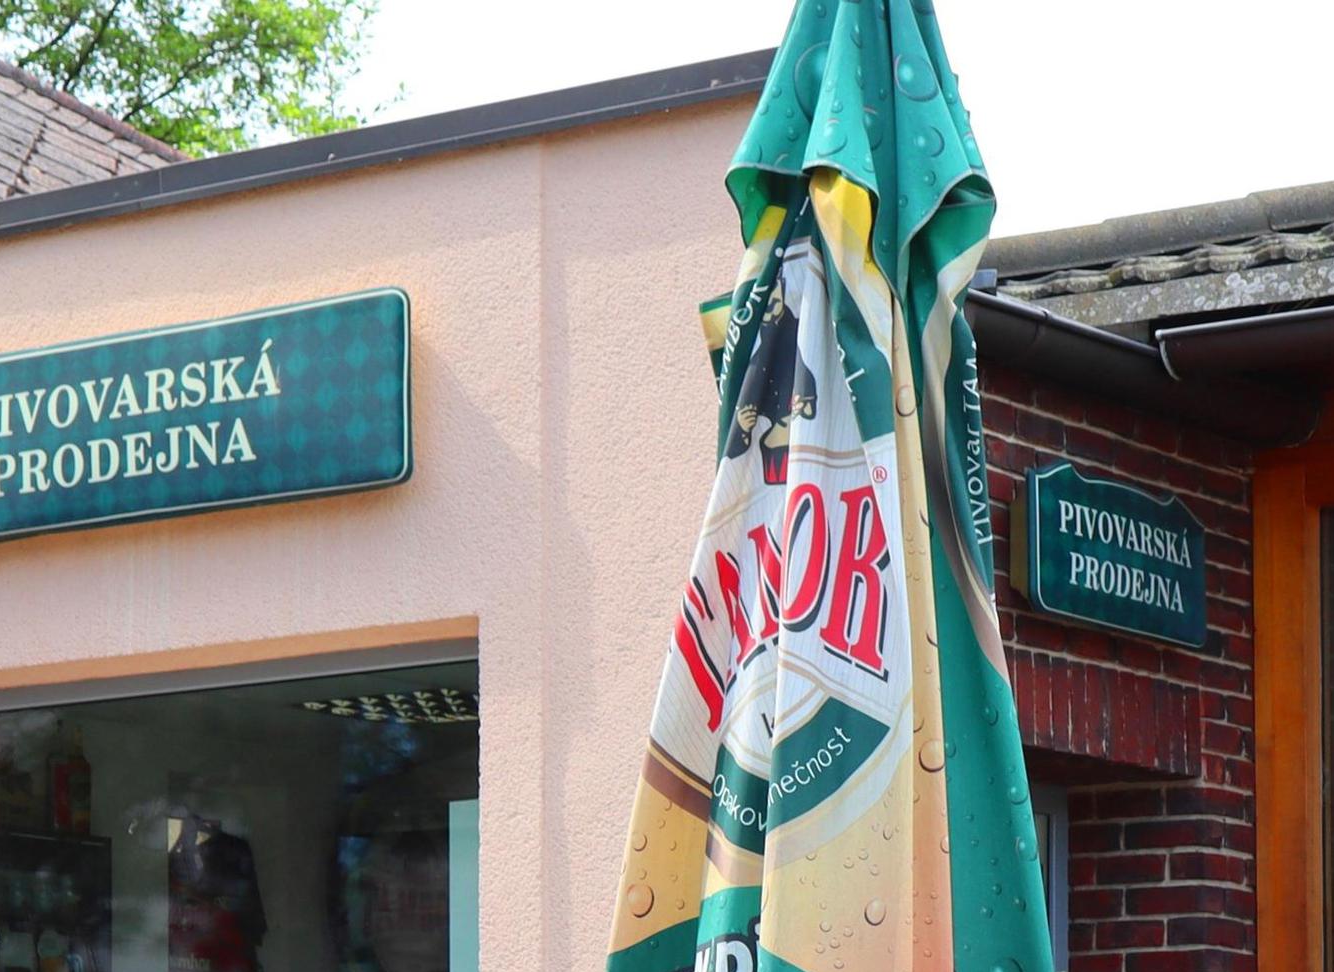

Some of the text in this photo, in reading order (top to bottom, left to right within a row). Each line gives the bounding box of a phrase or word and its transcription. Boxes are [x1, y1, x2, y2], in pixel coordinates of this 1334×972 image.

[1058, 499, 1193, 570] PIVOVARSKÁ
[1069, 551, 1185, 614] PRODEJNA
[713, 774, 767, 832] Opakov
